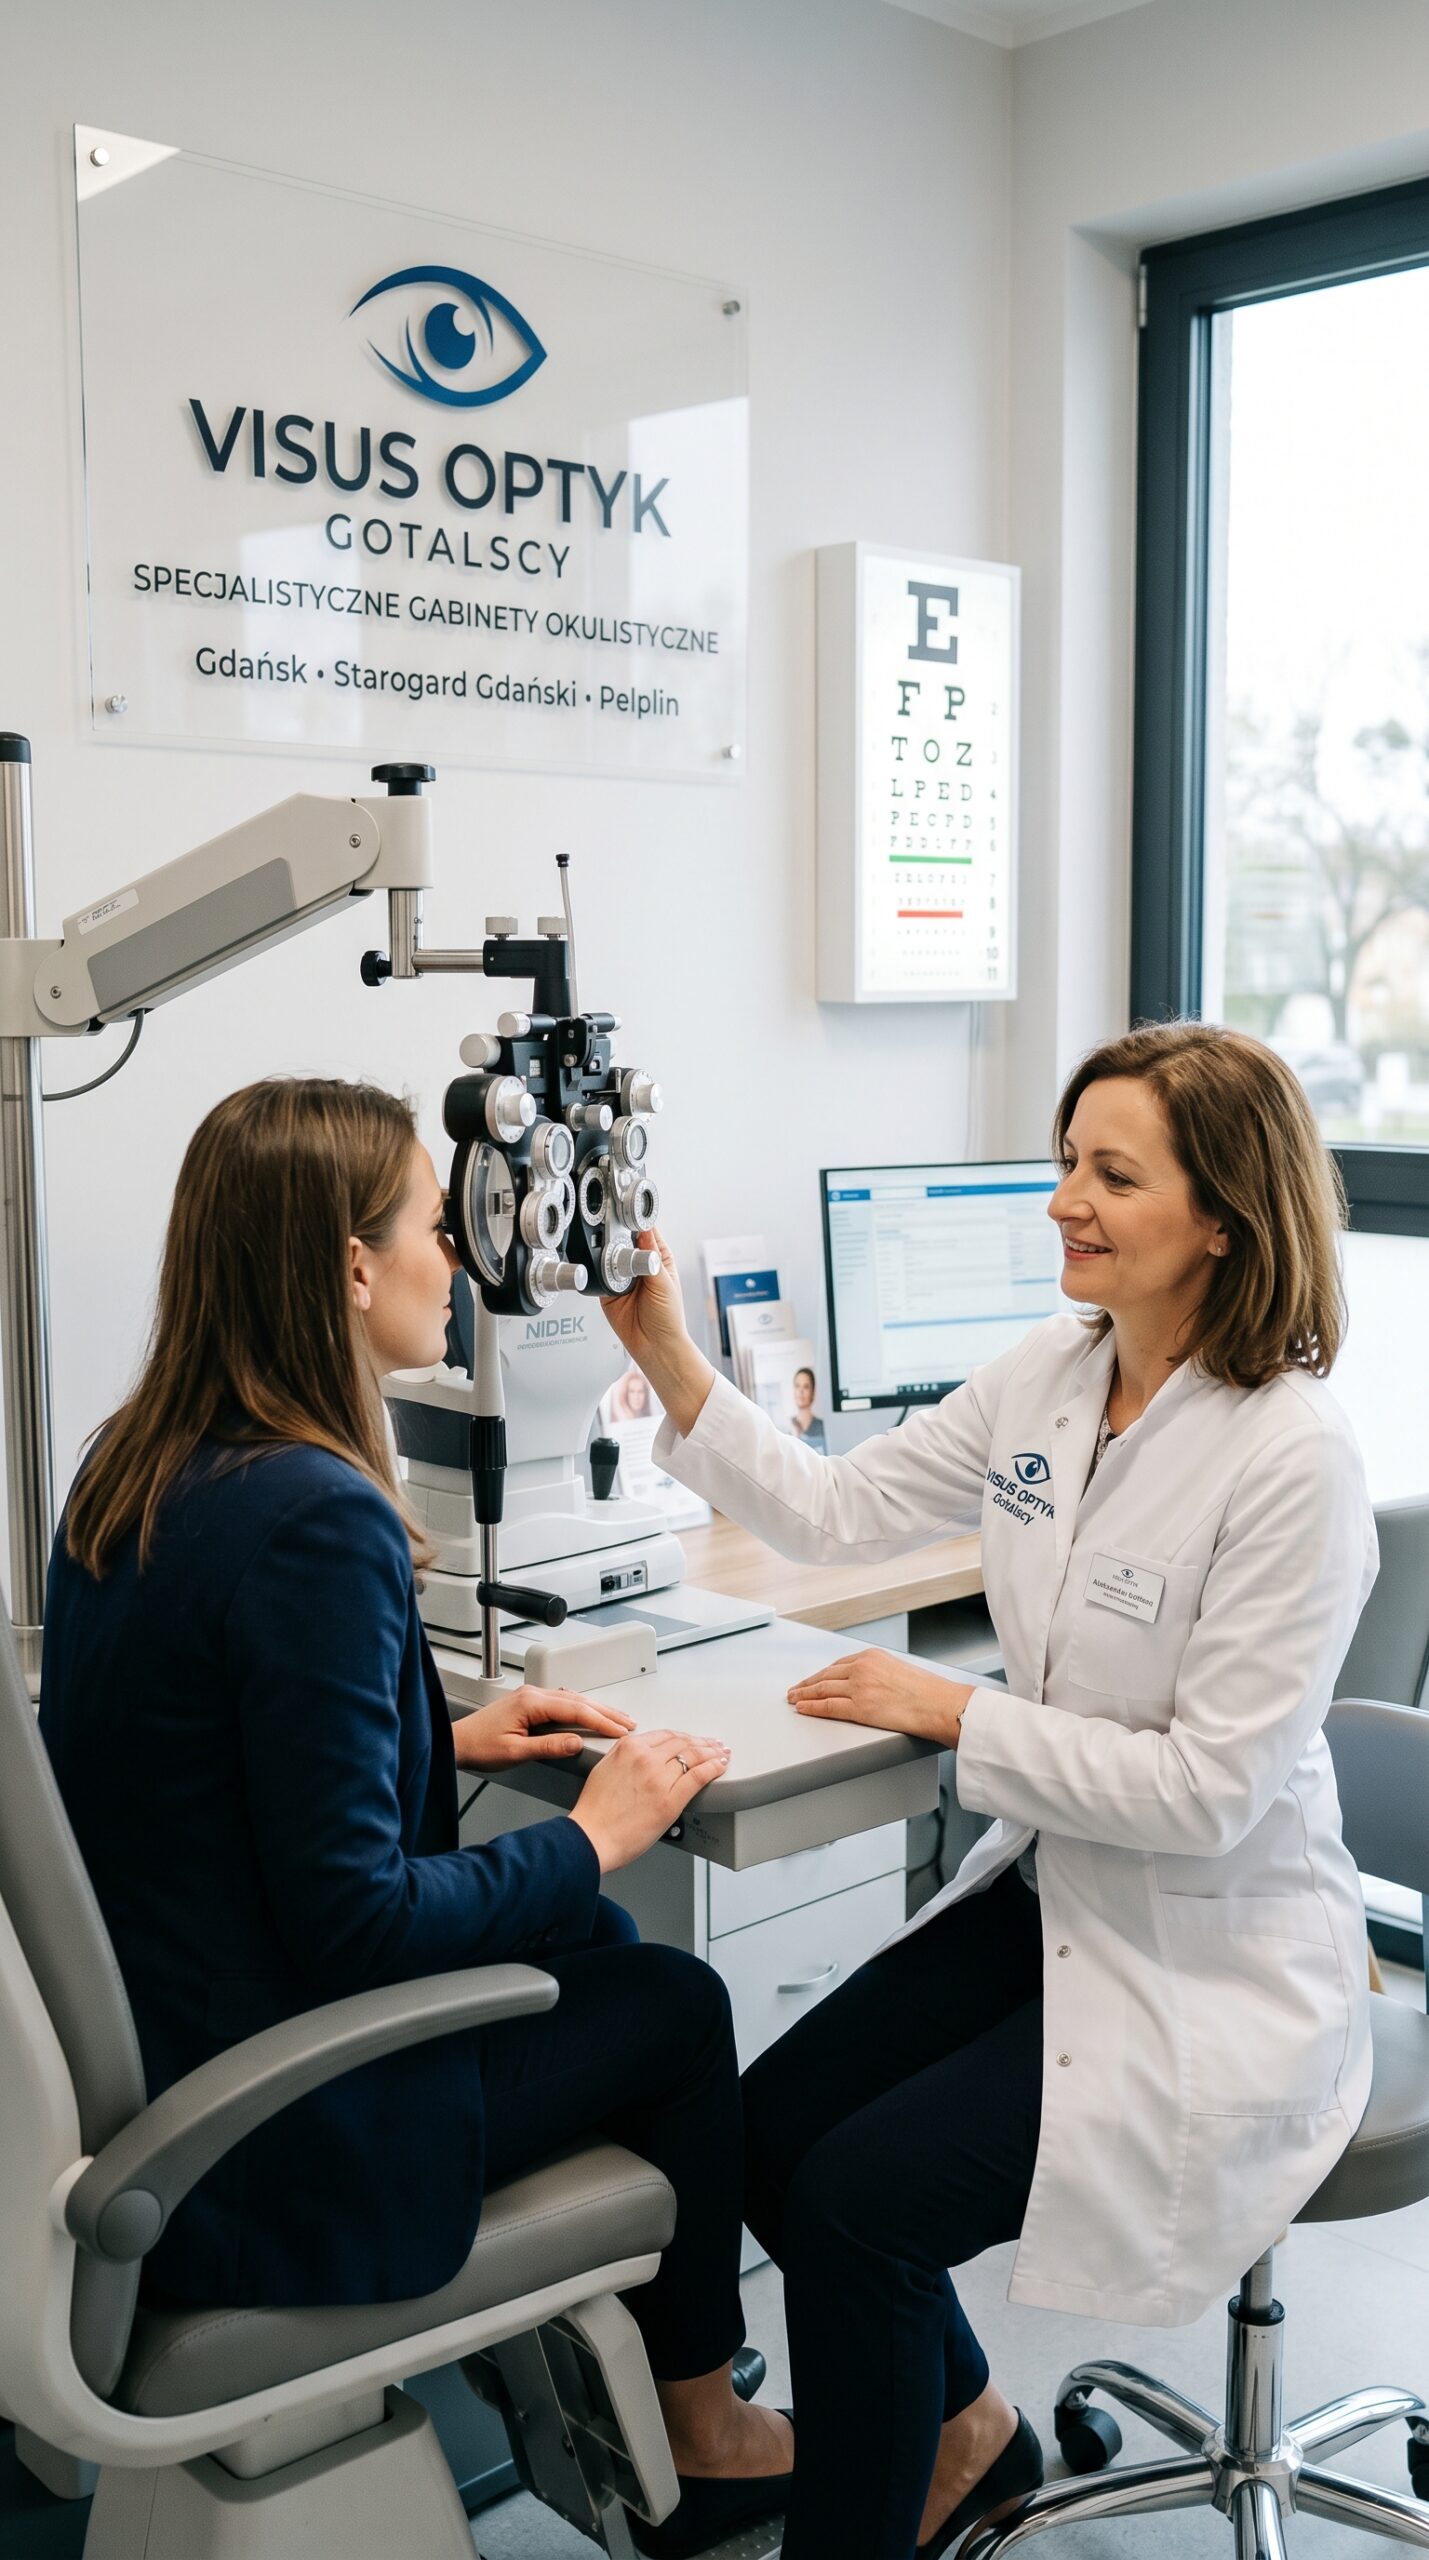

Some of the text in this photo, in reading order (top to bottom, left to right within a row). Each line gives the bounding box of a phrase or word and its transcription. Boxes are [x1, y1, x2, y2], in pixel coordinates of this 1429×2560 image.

[188, 398, 672, 537] VISUS OPTYK
[325, 513, 571, 579] GOTALSCY
[133, 563, 720, 656] SPECJALISTYCZNE GABINETY OKULISTYCZNE
[907, 580, 959, 665] E
[195, 645, 679, 719] Gdańsk Starogard Gdański Pelplin
[526, 1315, 585, 1340] NIDEK
